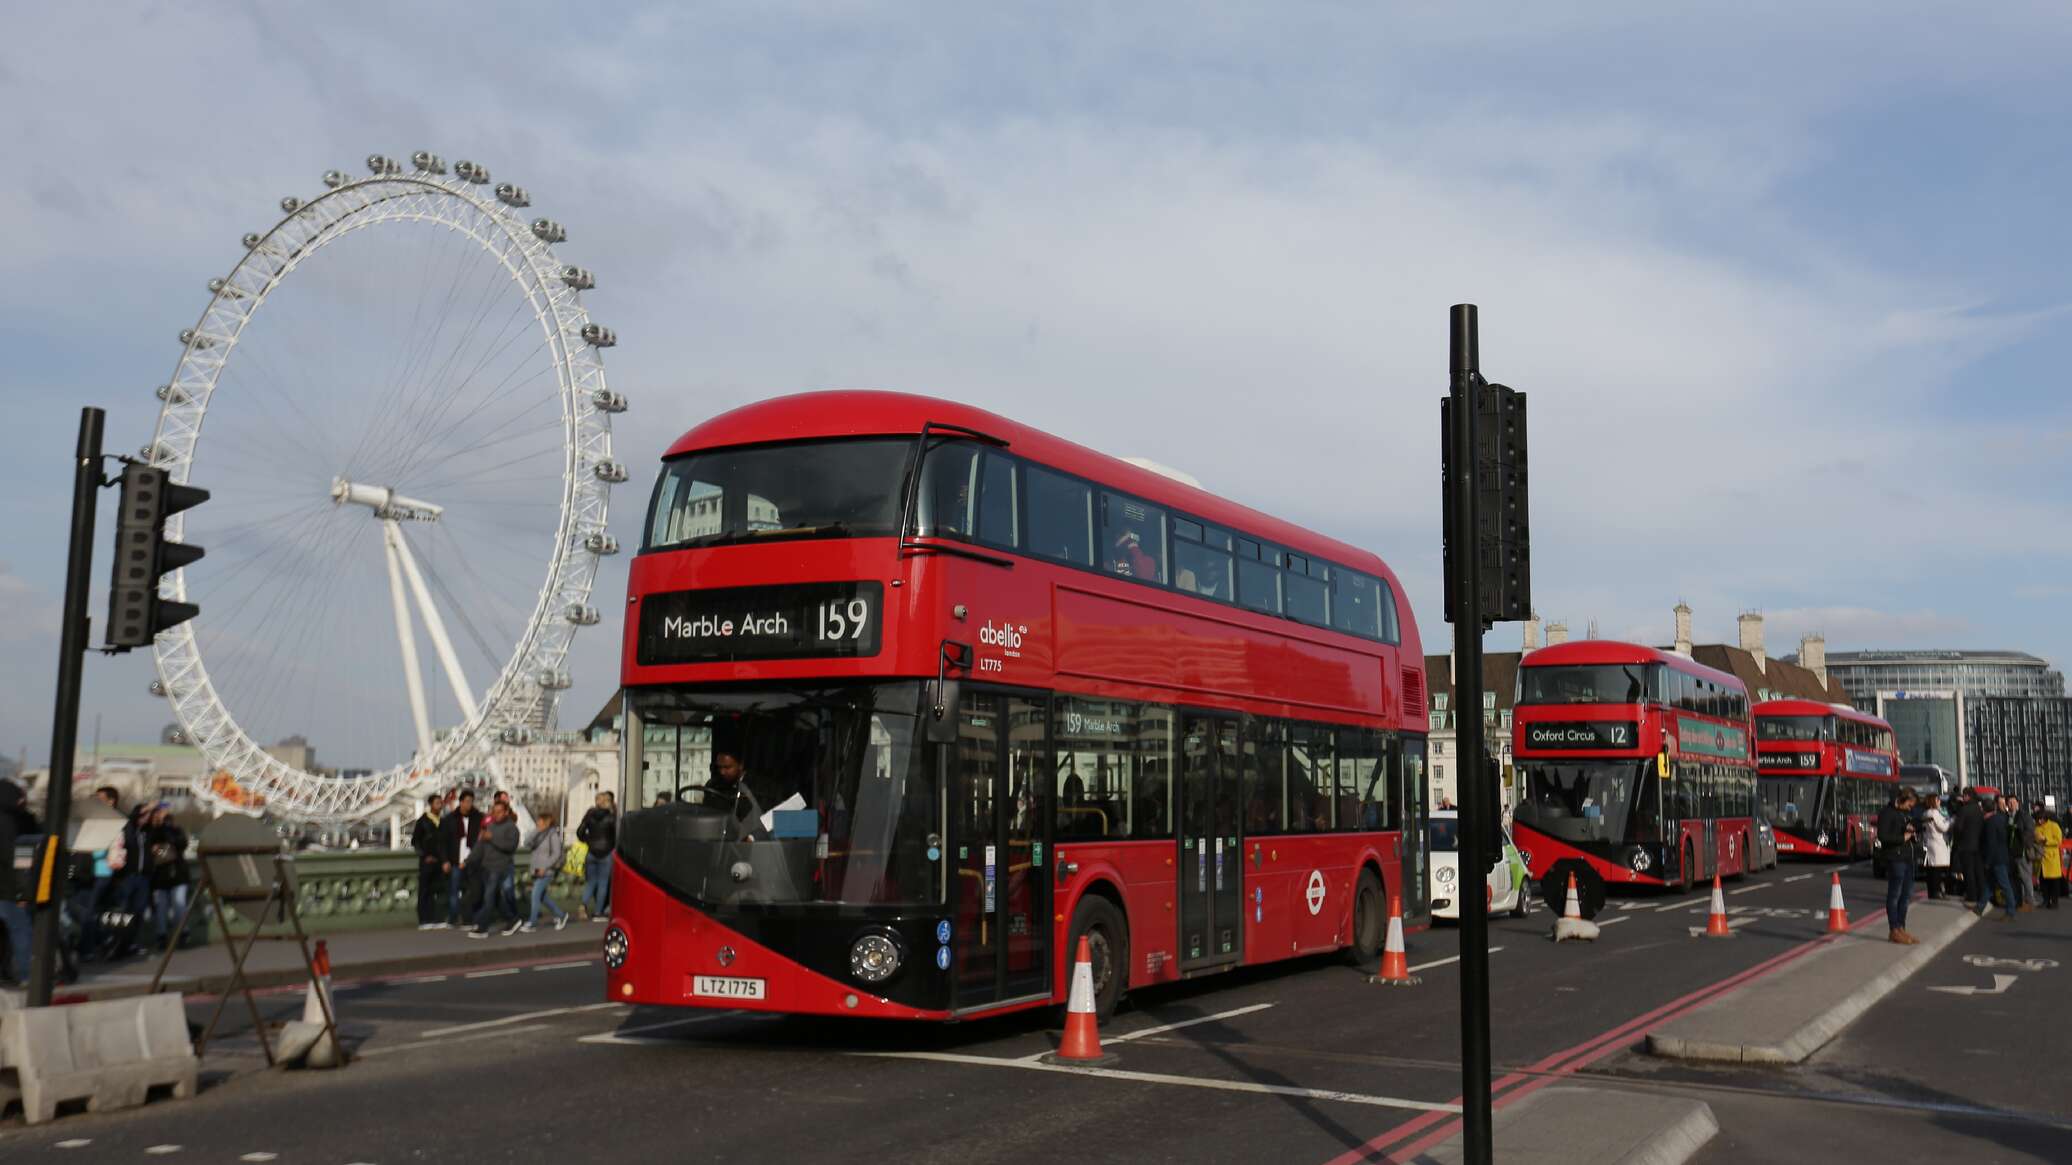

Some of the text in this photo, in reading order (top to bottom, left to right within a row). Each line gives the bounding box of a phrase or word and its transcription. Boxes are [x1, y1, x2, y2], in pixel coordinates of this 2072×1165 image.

[664, 612, 788, 639] Marble Arch
[819, 599, 868, 640] 159
[980, 619, 1022, 649] abellio
[980, 658, 1002, 672] LT775
[1066, 712, 1082, 734] 159
[1532, 729, 1595, 742] Oxford Circus
[1610, 726, 1627, 744] 12
[1800, 754, 1816, 767] 159
[701, 978, 757, 996] LTZ1775
